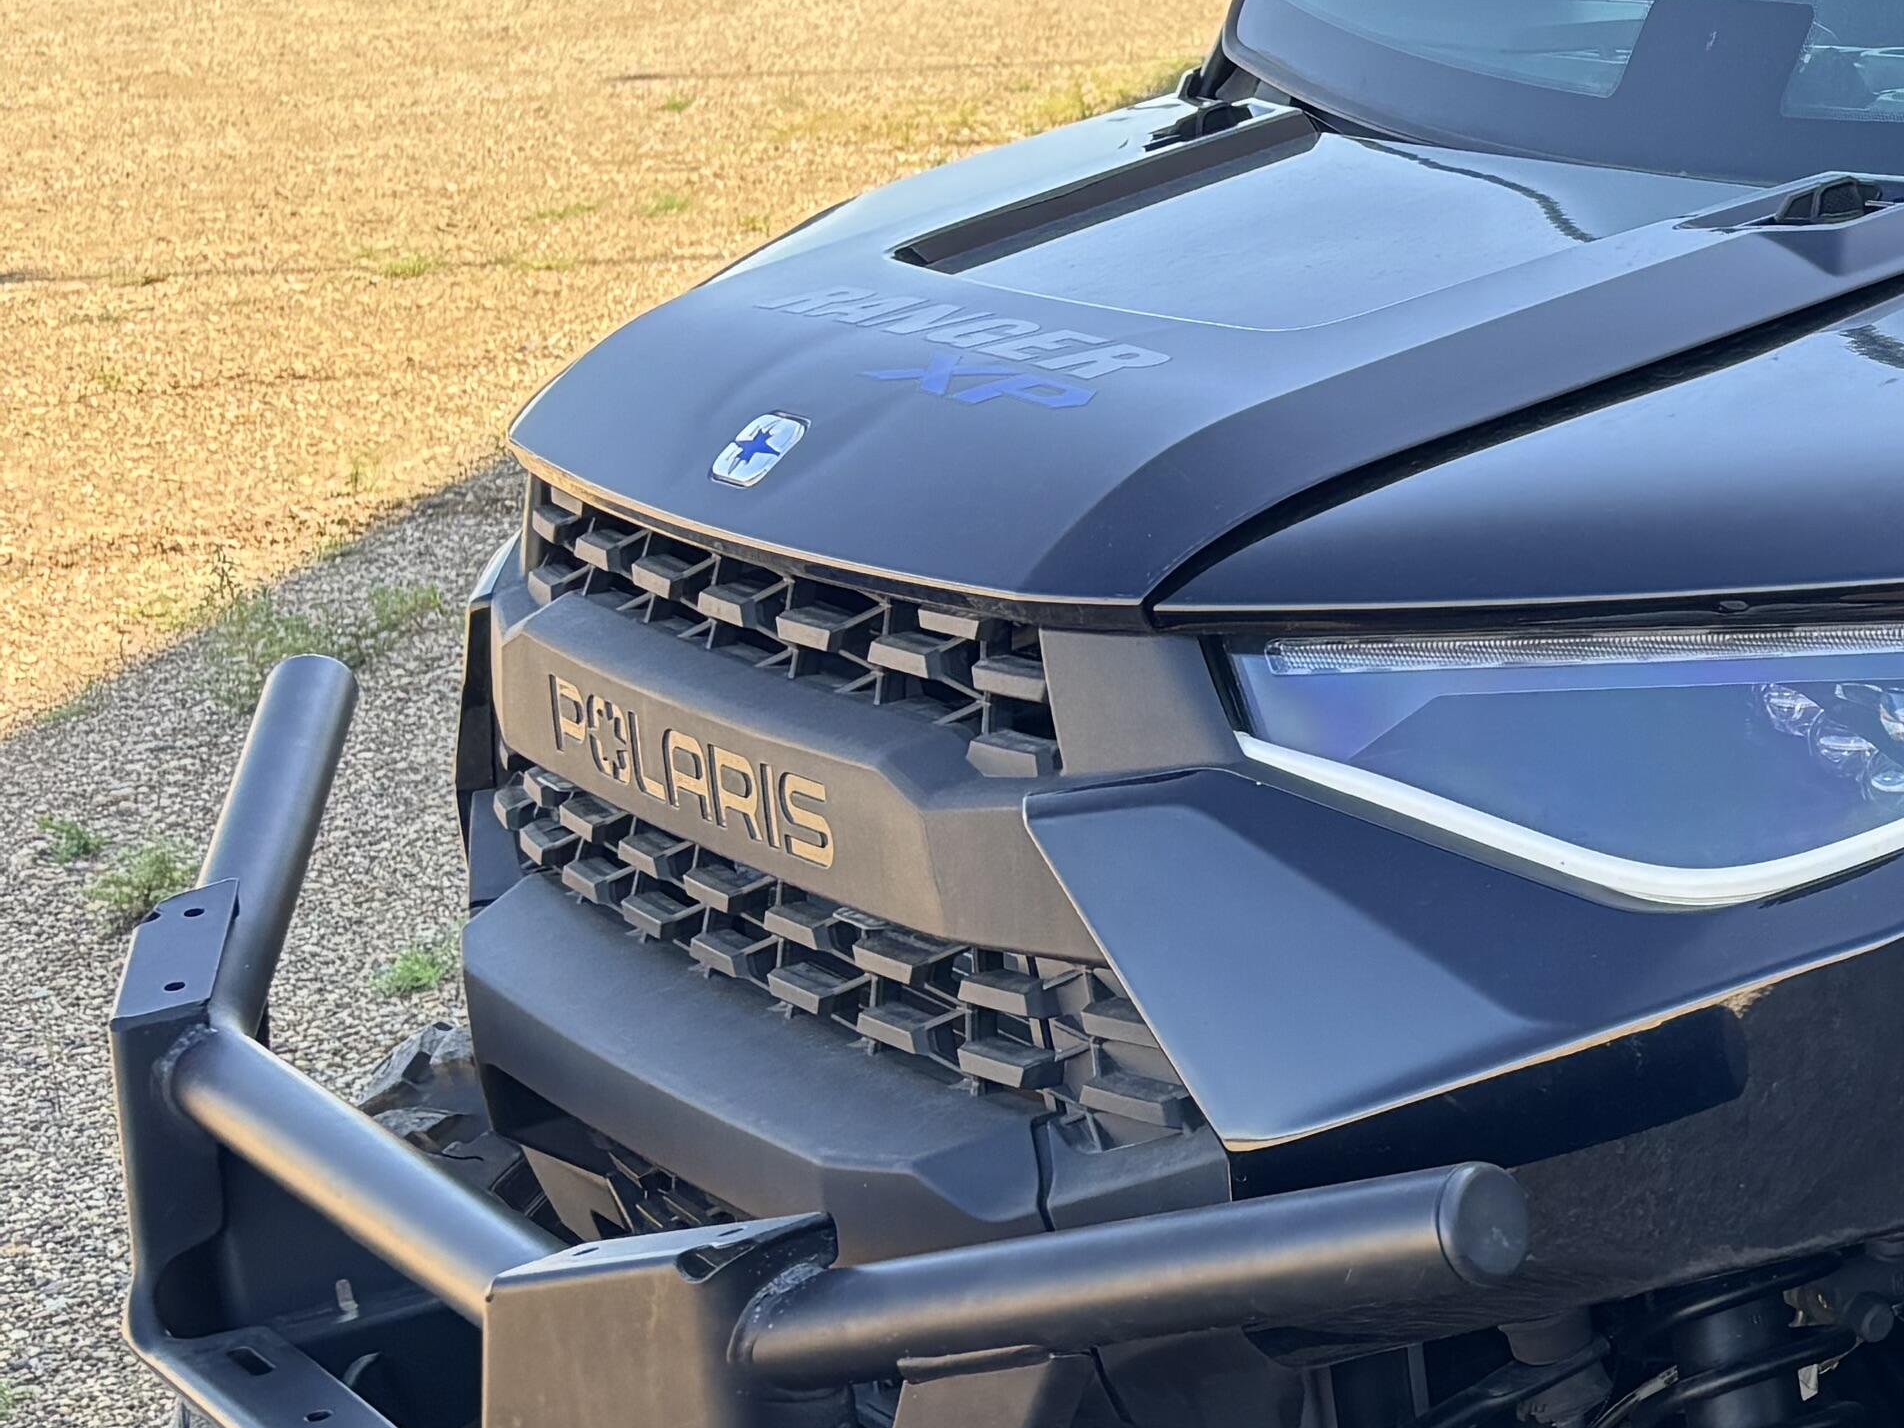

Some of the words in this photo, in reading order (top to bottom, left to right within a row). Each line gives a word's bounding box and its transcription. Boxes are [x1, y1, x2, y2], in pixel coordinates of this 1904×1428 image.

[756, 283, 1172, 380] RANGER
[860, 354, 1098, 409] XP
[549, 673, 835, 870] POLARIS
